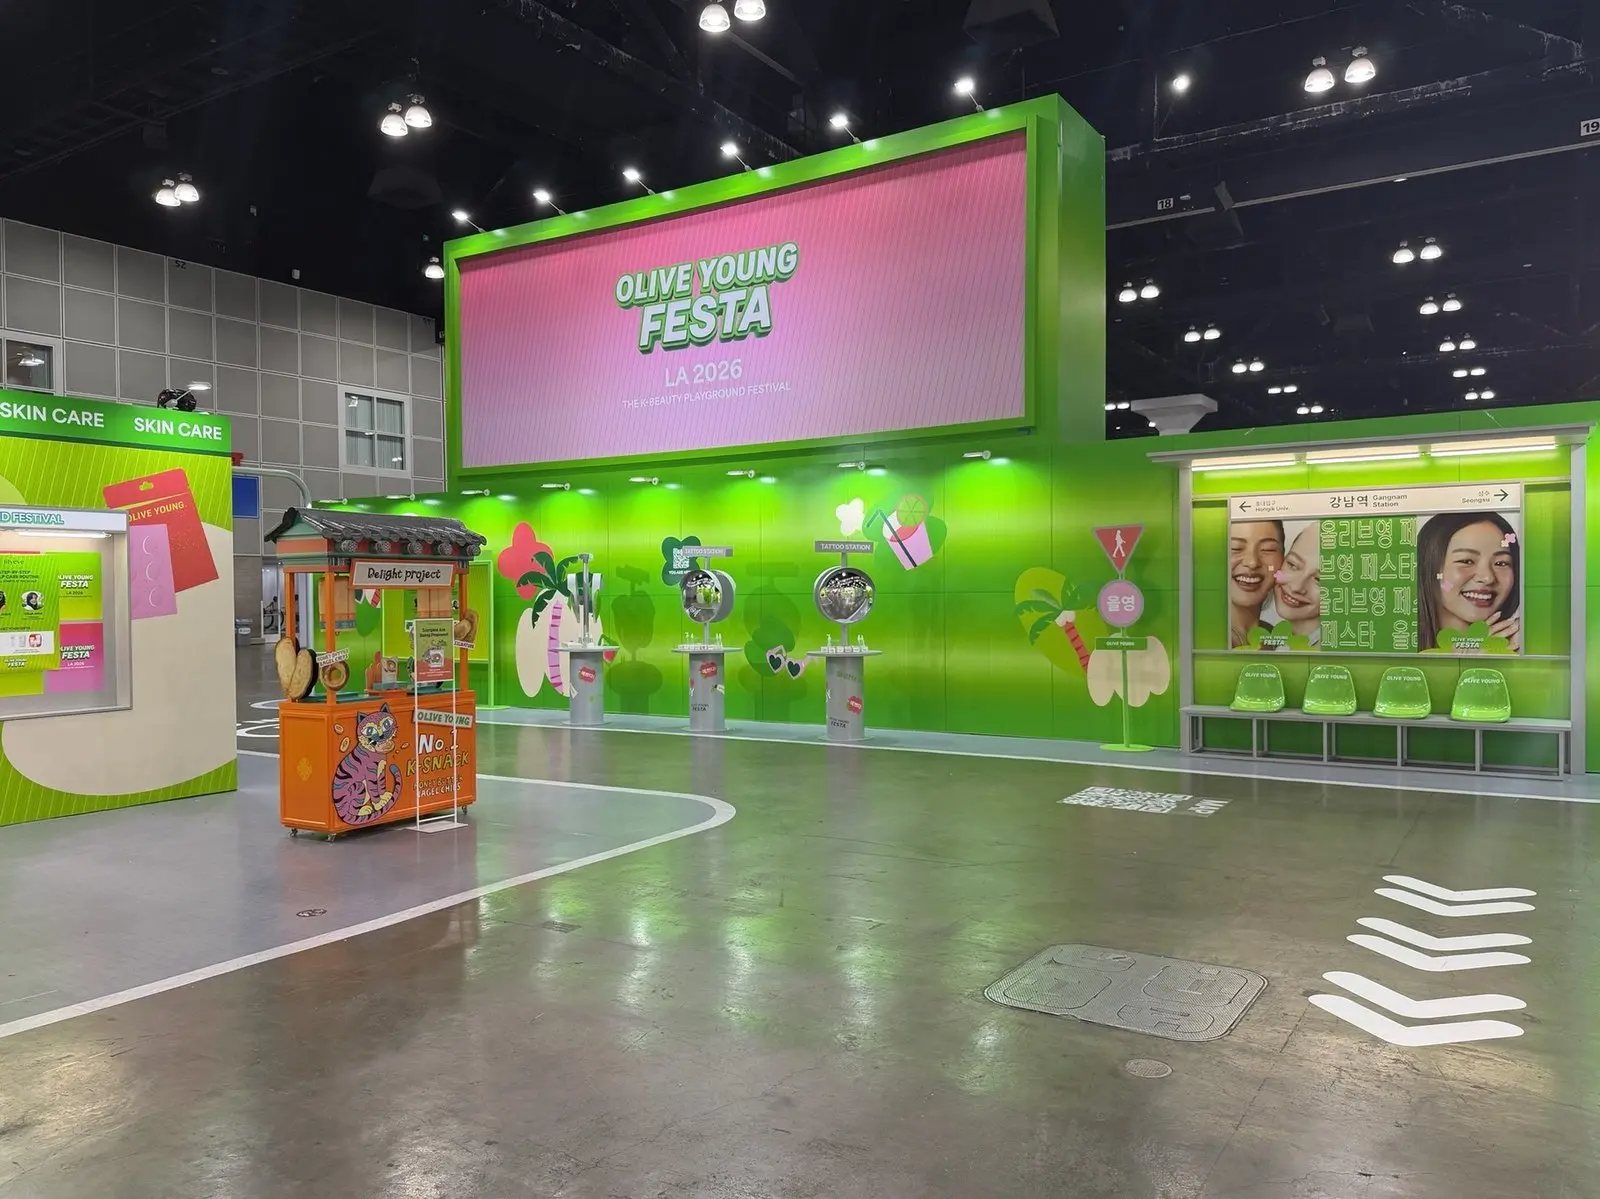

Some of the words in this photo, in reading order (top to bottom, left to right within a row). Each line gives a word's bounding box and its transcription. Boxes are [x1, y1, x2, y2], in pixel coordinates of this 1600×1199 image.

[1582, 121, 1600, 133] 19
[1158, 199, 1172, 209] 18
[615, 262, 694, 306] OLIVE
[698, 242, 798, 290] YOUNG
[638, 284, 773, 350] FESTA
[665, 367, 690, 387] LA
[693, 359, 743, 384] 2026
[622, 399, 640, 410] THE
[640, 394, 683, 408] K-BEAUTY
[684, 386, 746, 404] PLAYGROUND
[747, 381, 792, 397] FESTIVAL
[0, 401, 47, 422] SKIN
[52, 409, 105, 428] CARE
[134, 417, 174, 436] SKIN
[178, 422, 223, 441] CARE
[1329, 495, 1369, 509] 강남역
[1372, 493, 1408, 502] Gangnam
[154, 500, 186, 514] YOUNG
[1372, 501, 1400, 509] Station
[11, 511, 64, 525] FESTIVAL
[1320, 518, 1393, 550] 올리브영
[845, 543, 871, 551] STATION
[367, 567, 403, 581] Delight
[404, 568, 441, 582] project
[1320, 553, 1354, 583] 브영
[1360, 552, 1417, 582] 페스타
[60, 580, 89, 589] FESTA
[1320, 620, 1377, 649] 페스타
[62, 651, 90, 660] FESTA
[417, 711, 443, 723] OLIVE
